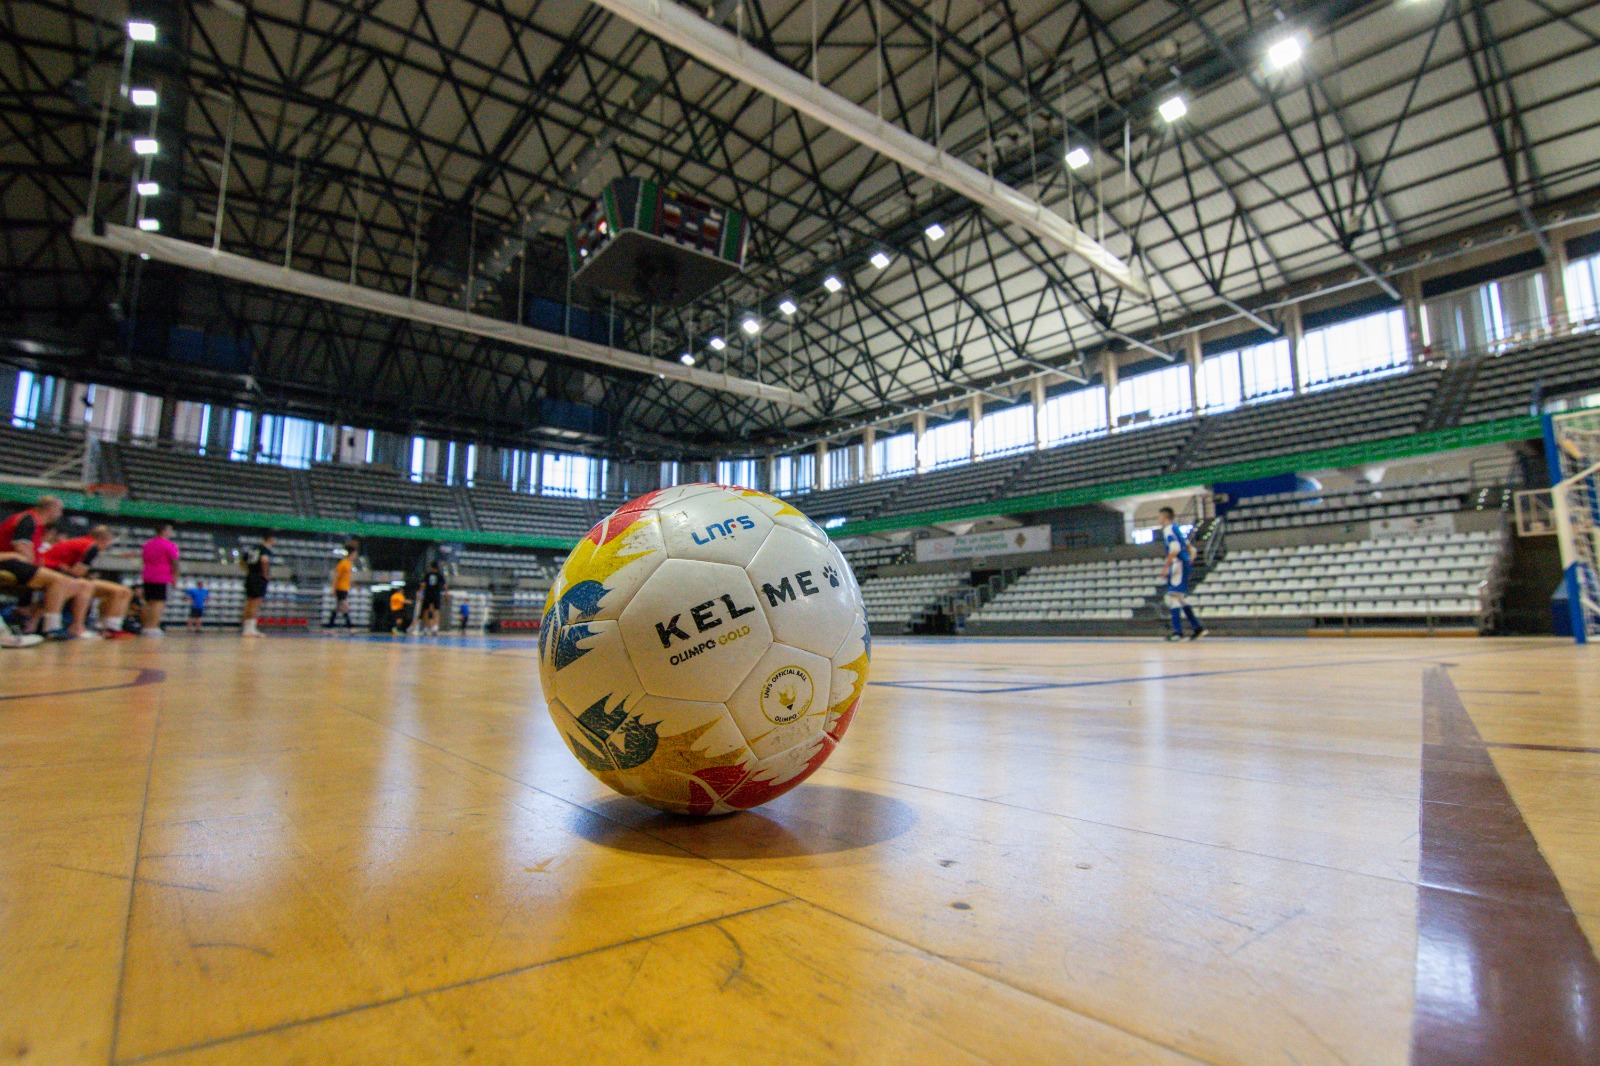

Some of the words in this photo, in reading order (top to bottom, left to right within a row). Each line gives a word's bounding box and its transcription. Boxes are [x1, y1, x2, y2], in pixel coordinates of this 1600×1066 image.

[669, 639, 717, 666] OLIMPO
[718, 625, 751, 646] GOLD
[771, 669, 796, 683] OFFICIAL
[796, 670, 807, 683] BALL
